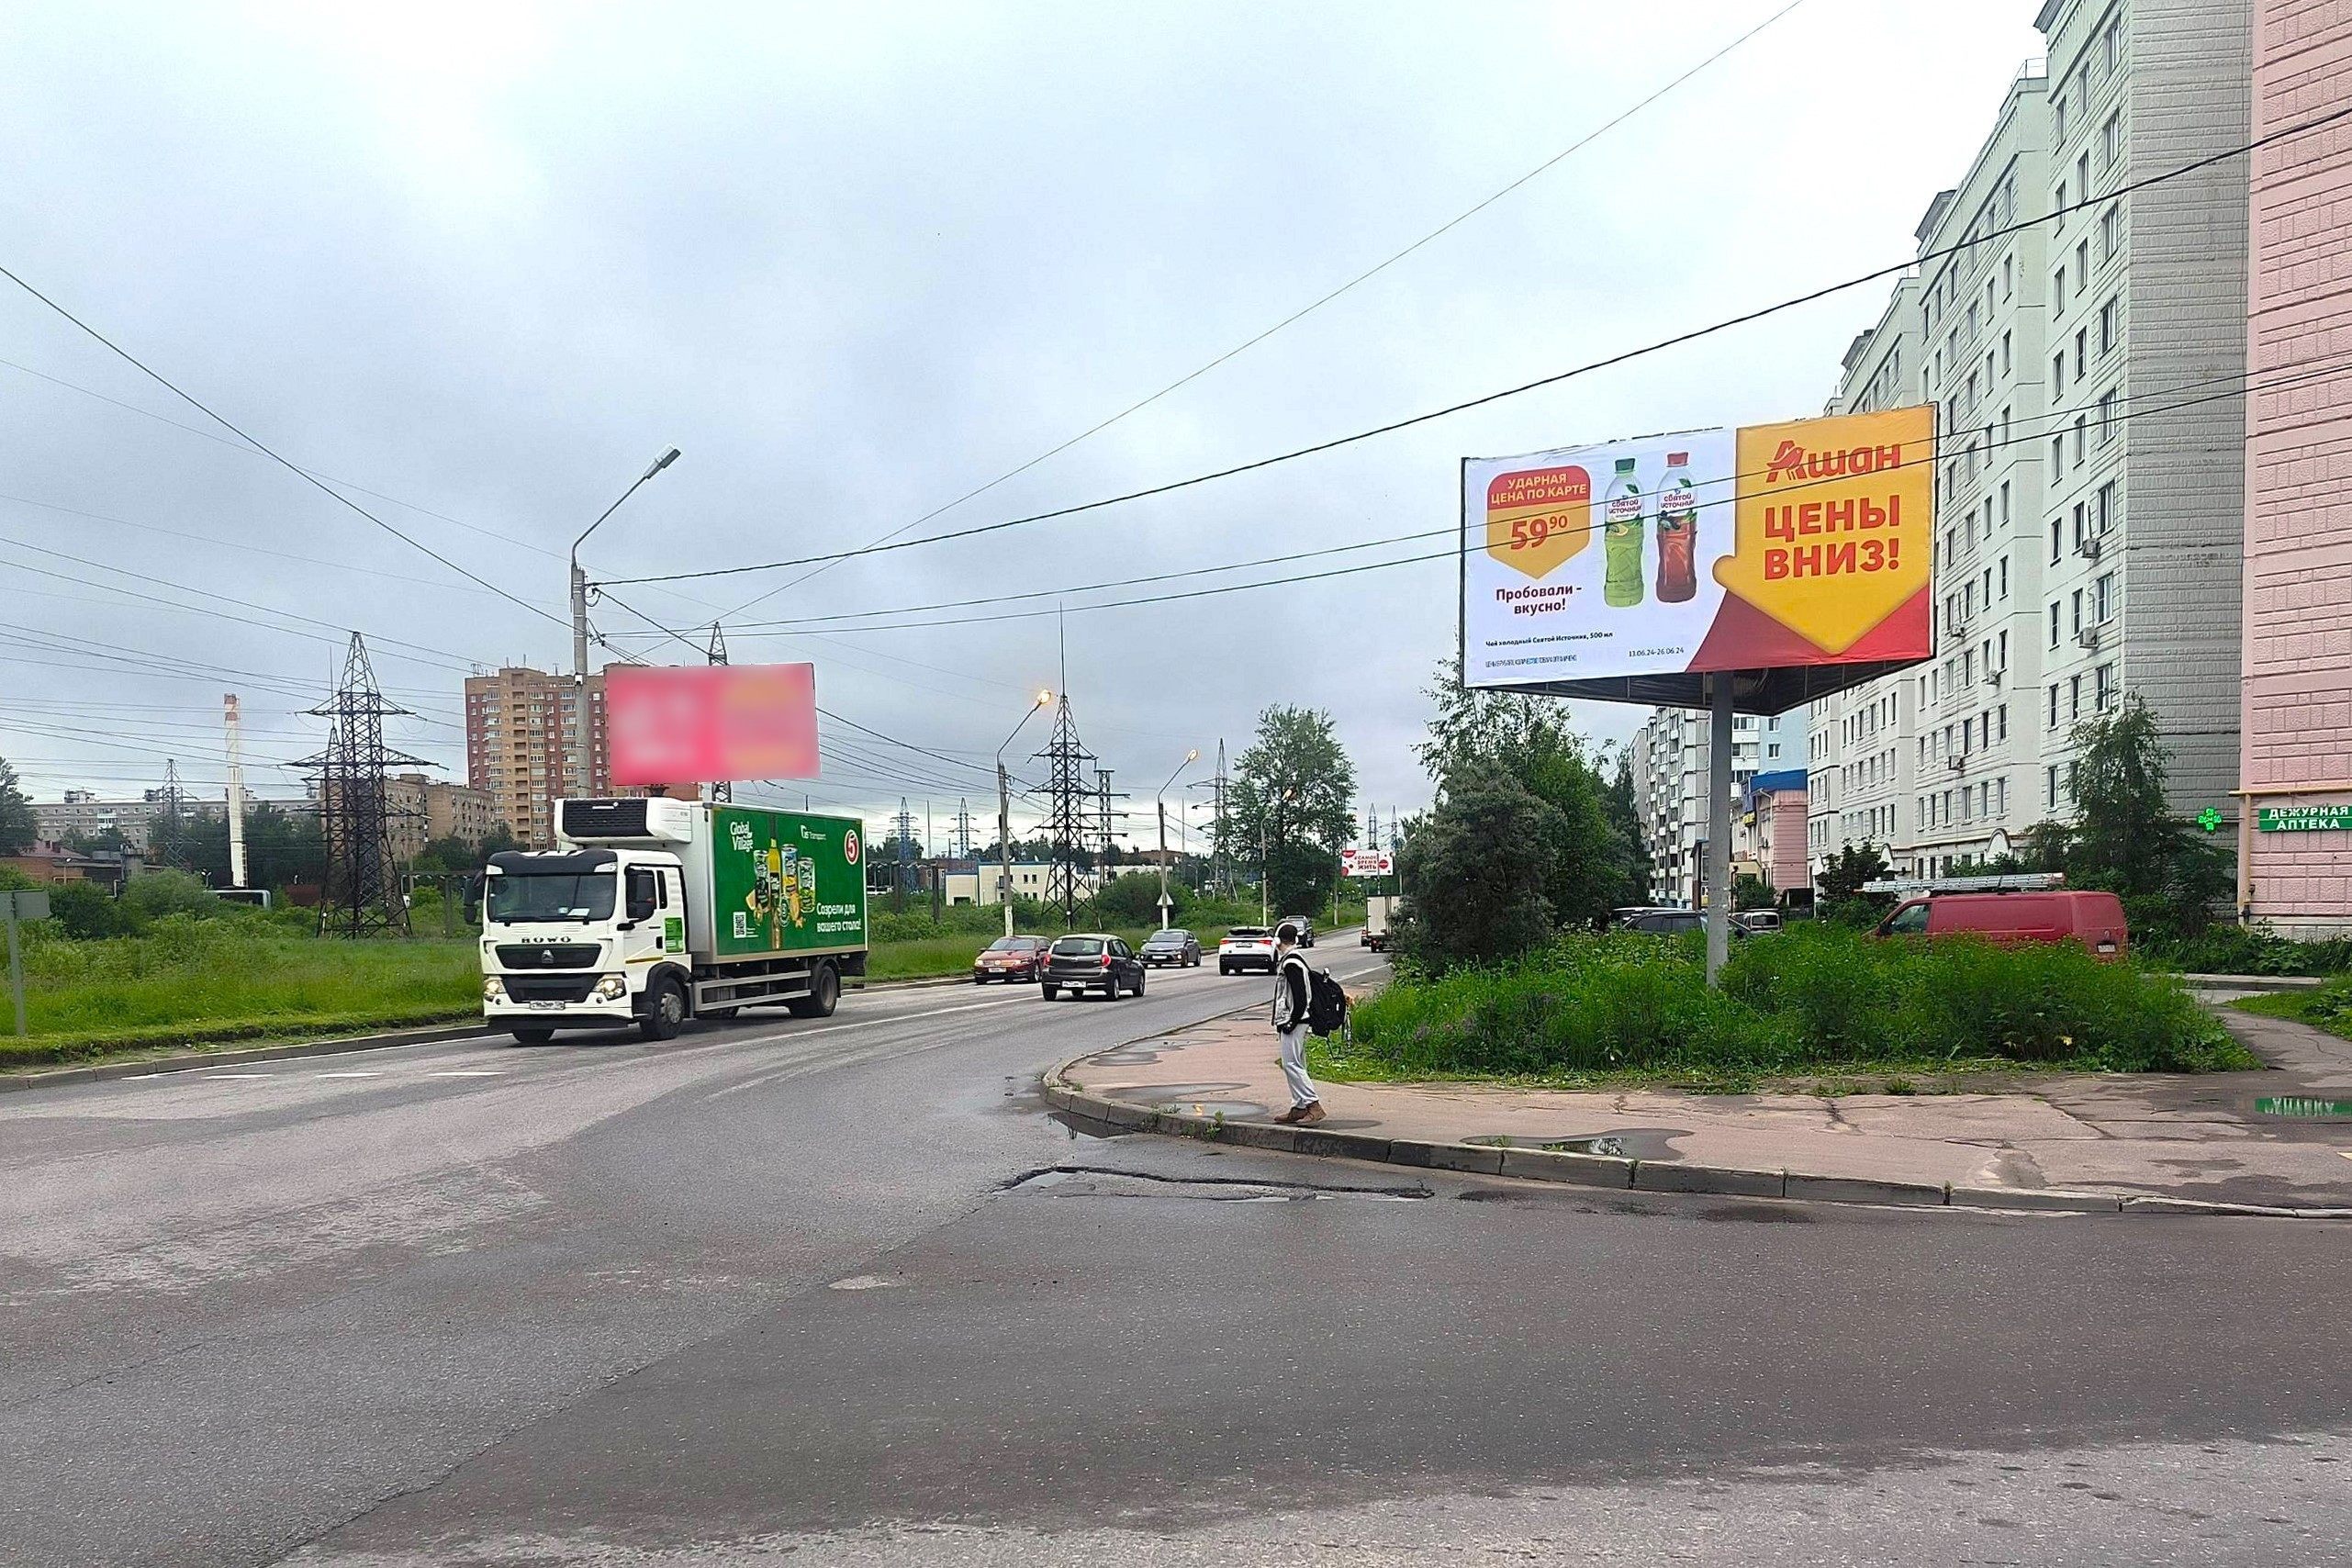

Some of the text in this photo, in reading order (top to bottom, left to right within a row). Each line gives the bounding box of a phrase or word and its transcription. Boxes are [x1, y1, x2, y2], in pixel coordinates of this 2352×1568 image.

[1508, 474, 1567, 489] УДАРНАЯ
[1491, 484, 1586, 505] ЦЕНА ПО КАРТЕ
[1765, 495, 1899, 543] ЦЕНЫ
[1764, 538, 1899, 580] ВНИЗ!
[1496, 585, 1574, 603] Пробовали
[1514, 598, 1566, 616] вкусно!
[2268, 806, 2349, 821] ДЕЖУРНАЯ
[730, 821, 750, 836] Global
[2276, 818, 2340, 831] АПТЕКА
[732, 834, 754, 852] Village
[816, 902, 844, 918] Созрели
[816, 922, 842, 933] вашего
